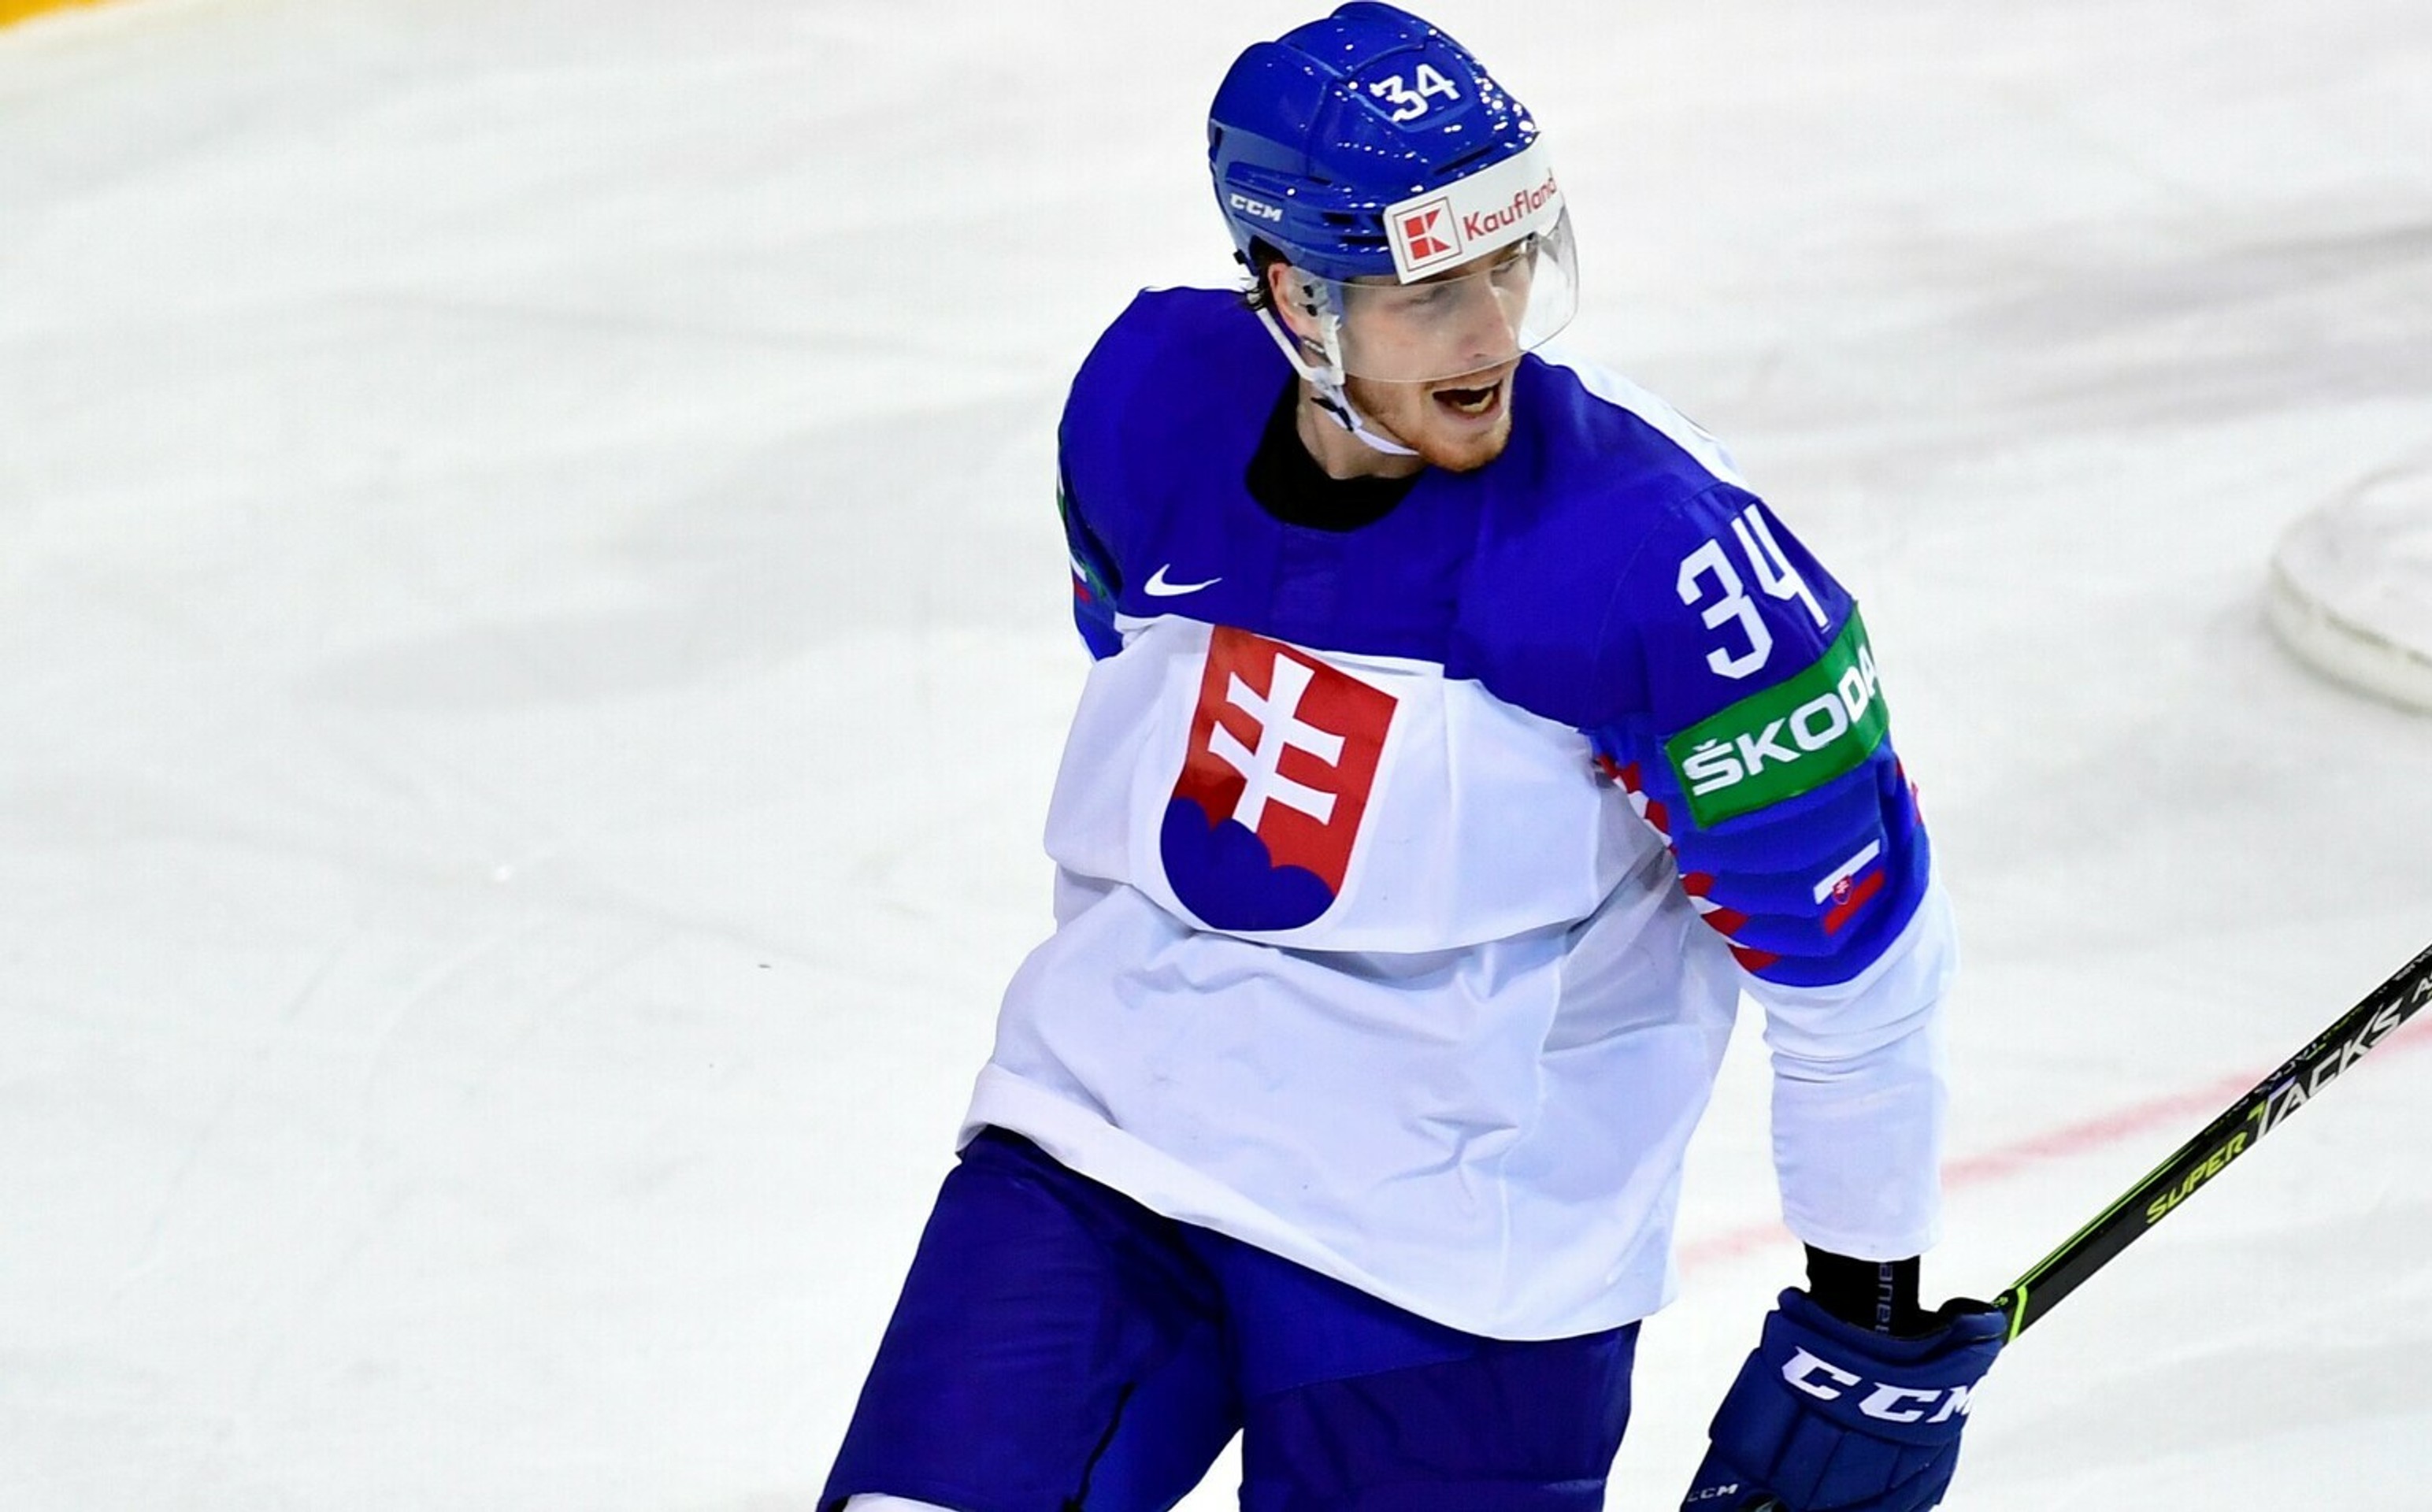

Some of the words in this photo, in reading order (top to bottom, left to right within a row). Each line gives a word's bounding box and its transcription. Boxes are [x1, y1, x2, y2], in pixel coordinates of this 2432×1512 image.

[1370, 63, 1460, 122] 34
[1229, 193, 1284, 223] CCM
[1463, 168, 1558, 242] Kaufland
[1676, 503, 1830, 680] 34
[1681, 643, 1878, 797] ŠKODA
[2146, 1132, 2248, 1225] SUPER
[2247, 996, 2403, 1142] TACKS
